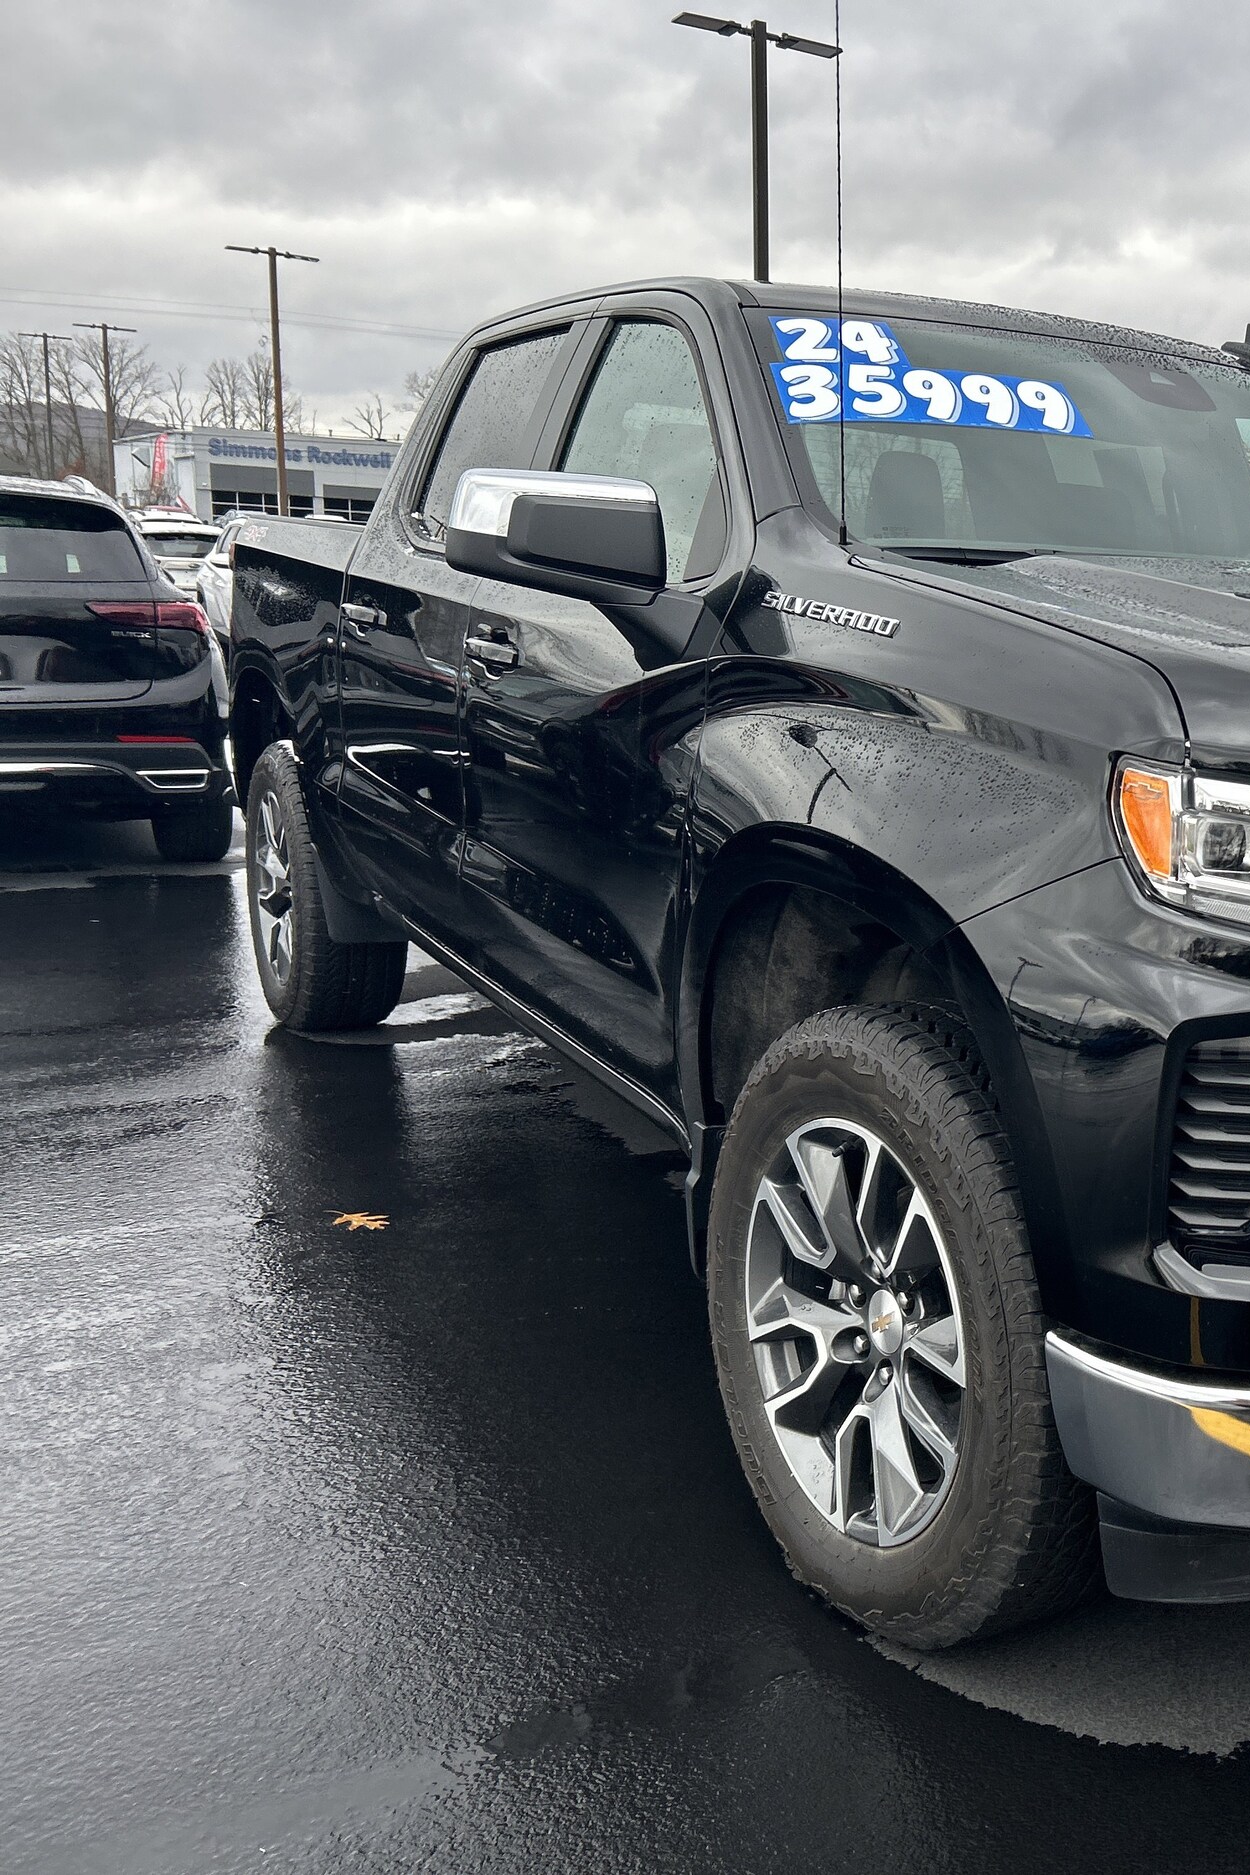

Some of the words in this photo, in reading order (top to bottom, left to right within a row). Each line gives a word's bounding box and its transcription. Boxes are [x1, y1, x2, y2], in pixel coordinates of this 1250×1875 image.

[775, 318, 899, 364] 24
[779, 363, 1076, 434] 35999
[208, 437, 302, 462] Simmons
[307, 445, 391, 469] Rockwell
[761, 590, 901, 639] SILVERADO
